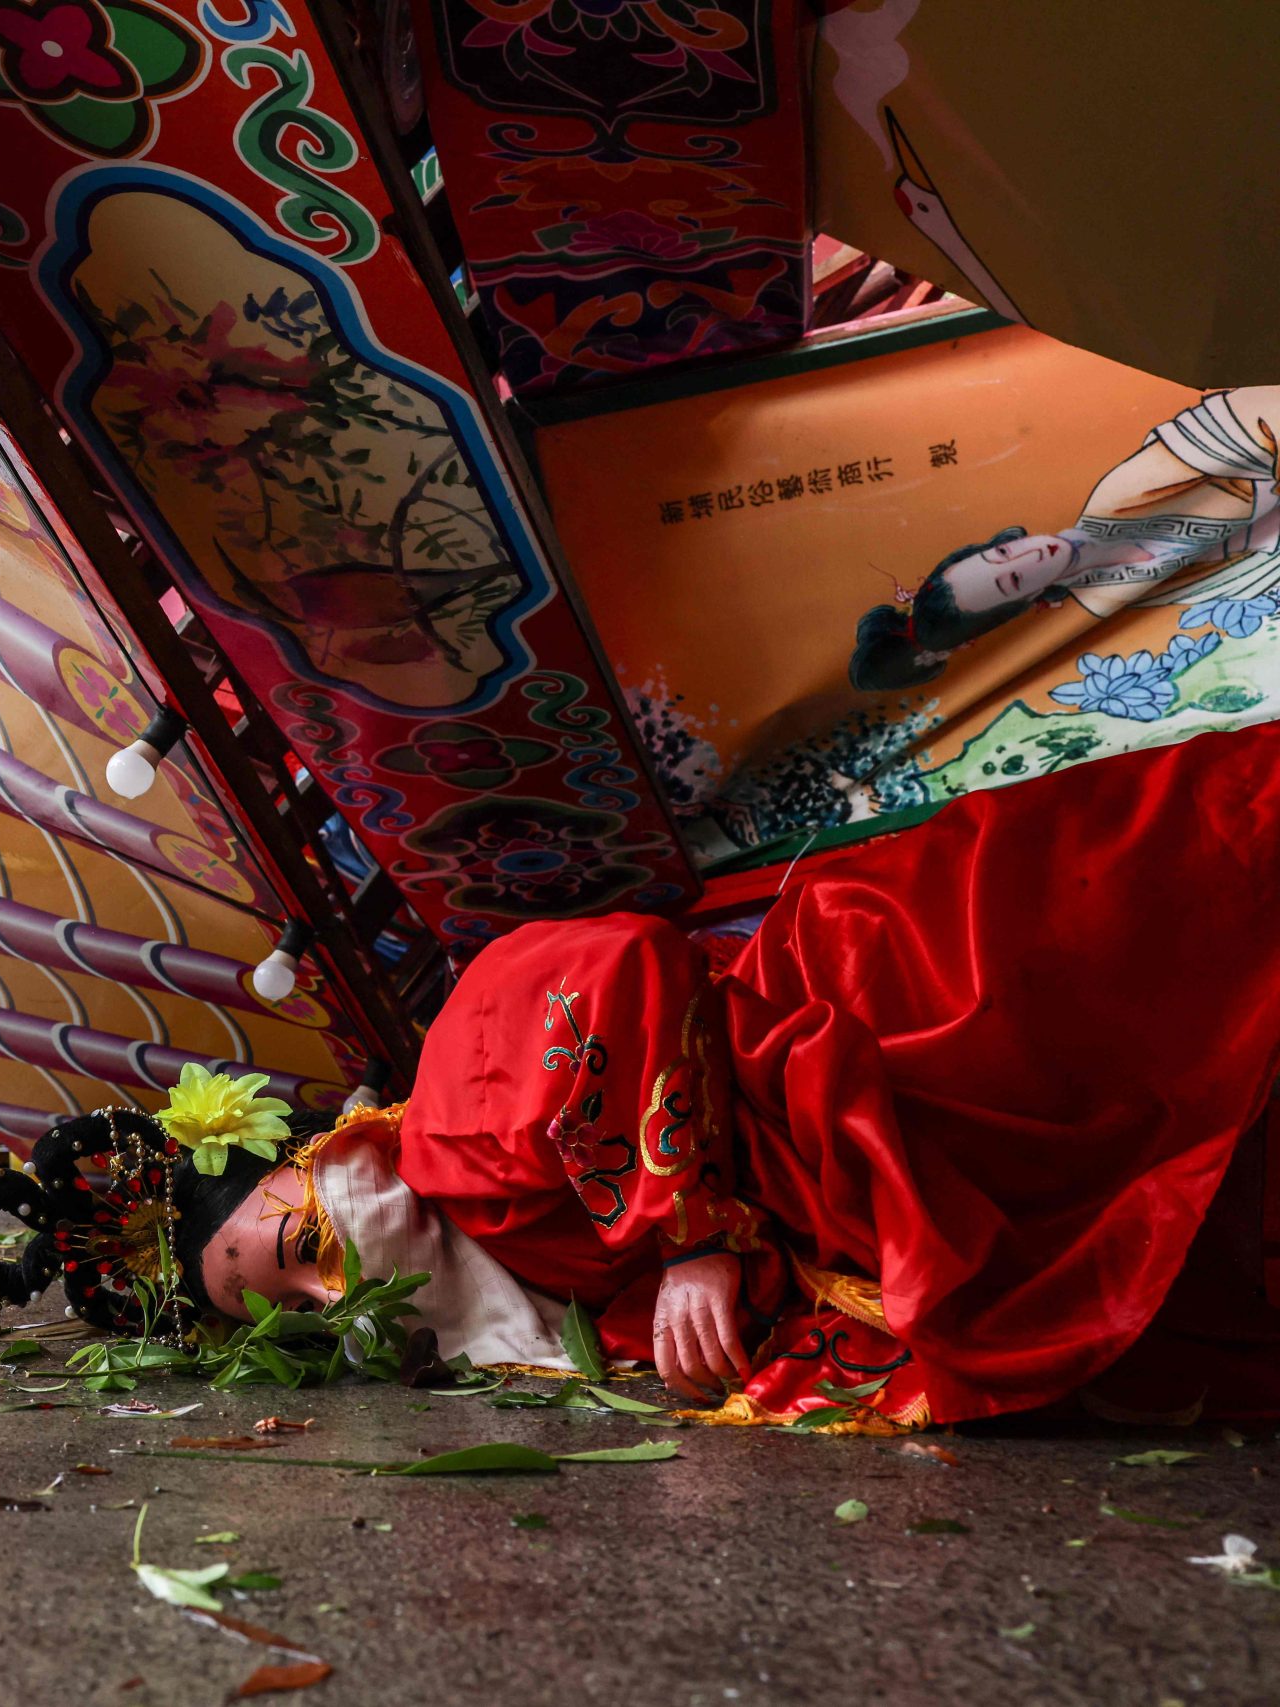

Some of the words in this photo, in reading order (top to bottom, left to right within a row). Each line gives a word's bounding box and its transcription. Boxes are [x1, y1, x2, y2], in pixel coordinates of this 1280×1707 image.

[659, 456, 894, 525] 新埔民俗藝術商行
[927, 439, 958, 469] 製
